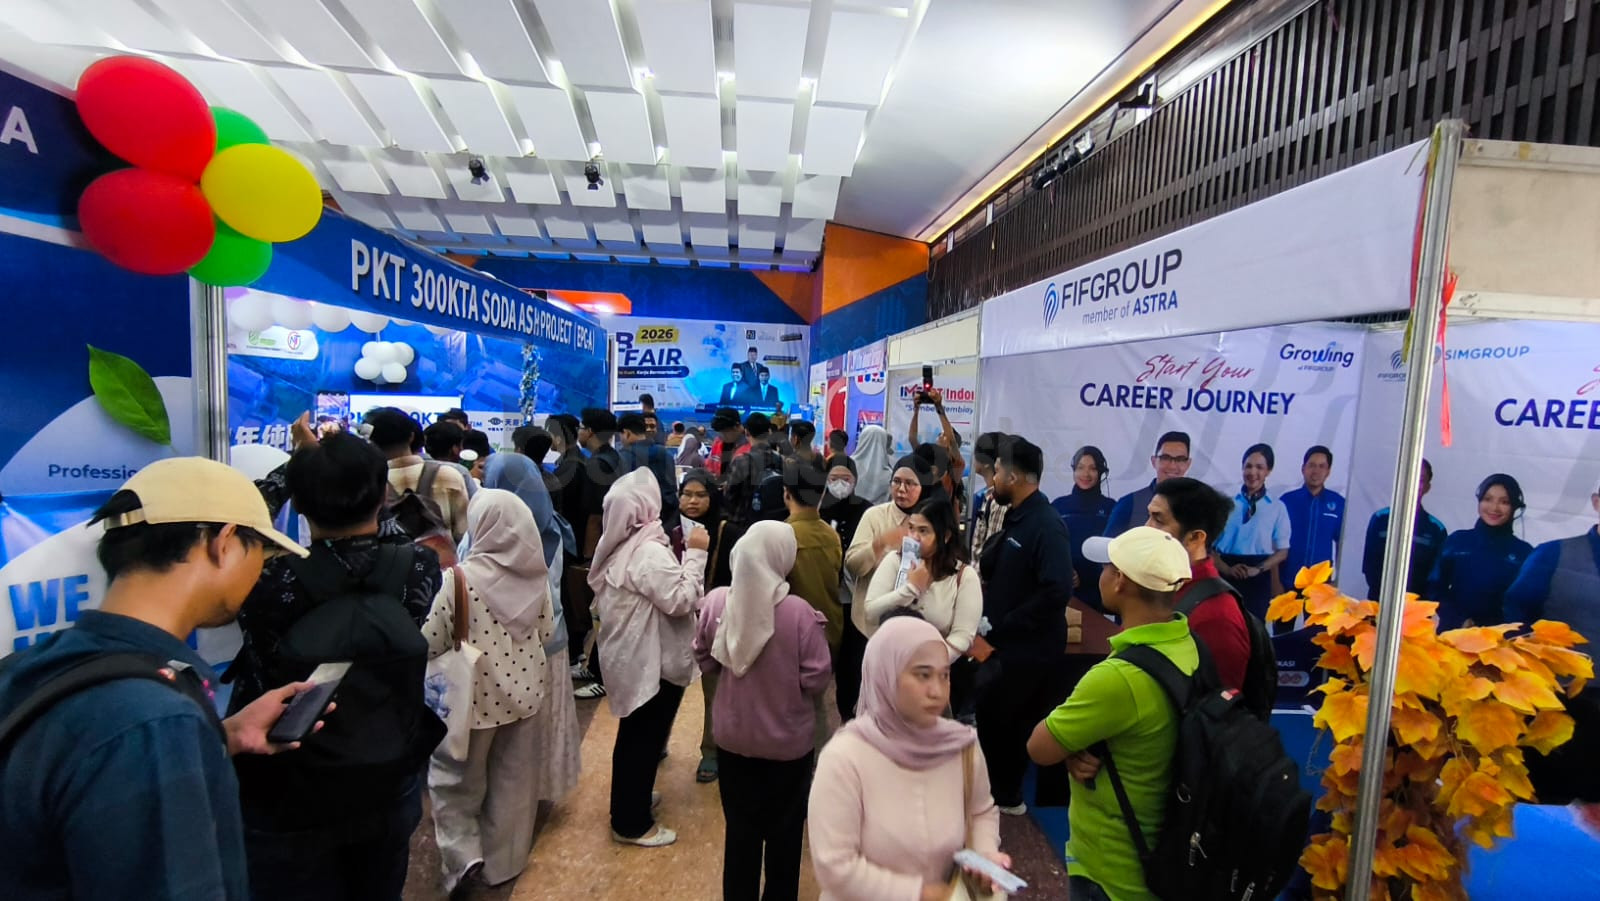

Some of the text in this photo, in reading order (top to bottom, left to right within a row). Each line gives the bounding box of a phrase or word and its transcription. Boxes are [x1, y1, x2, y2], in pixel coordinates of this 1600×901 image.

[0, 105, 39, 154] A
[350, 238, 407, 302] PKT
[410, 264, 479, 322] 300KTA
[481, 289, 517, 330] SODA
[517, 303, 540, 337] ASH
[540, 310, 573, 345] PROJECT
[1061, 248, 1183, 309] FIFGROUP
[1082, 290, 1179, 326] member of ASTRA
[641, 328, 674, 340] 2026
[624, 347, 682, 366] FAIR
[1137, 354, 1255, 391] Start Your
[1279, 341, 1354, 368] Growing
[1079, 382, 1296, 416] CAREER JOURNEY
[48, 463, 139, 480] Professio
[8, 574, 89, 631] WE
